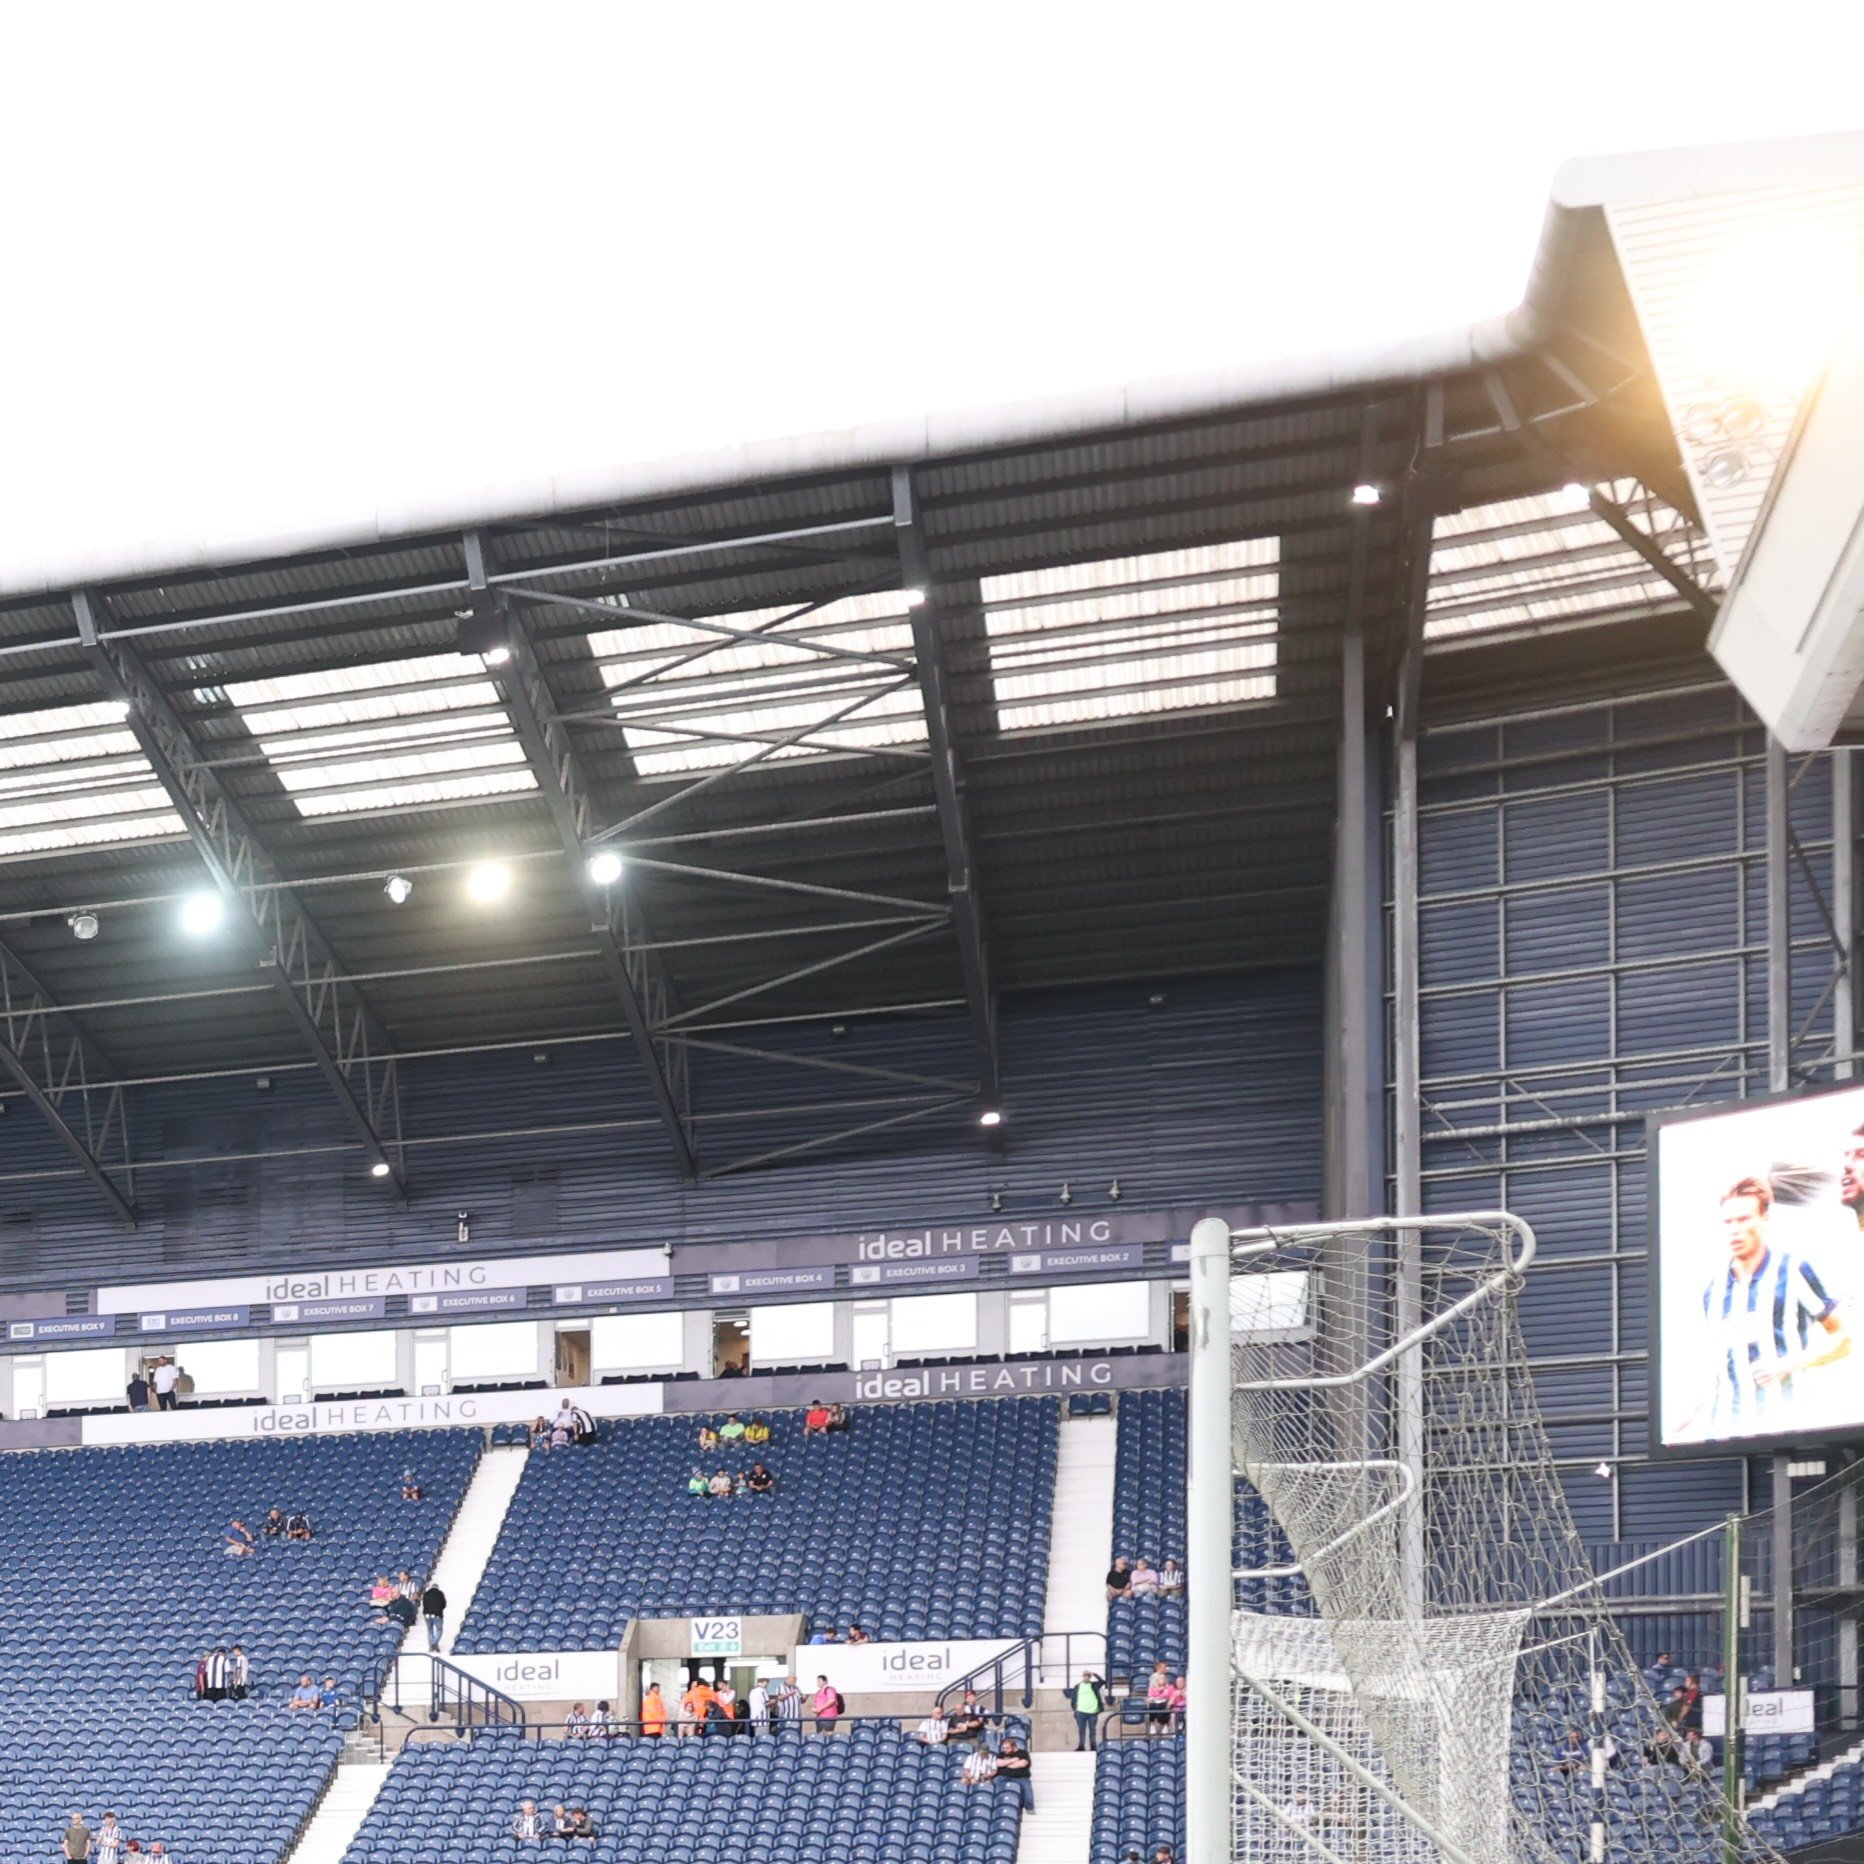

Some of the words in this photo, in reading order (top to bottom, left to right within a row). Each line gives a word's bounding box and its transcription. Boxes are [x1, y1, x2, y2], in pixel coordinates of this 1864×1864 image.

[858, 1231, 931, 1260] ideal
[943, 1221, 1110, 1251] HEATING
[1047, 1253, 1098, 1266] EXECUTIVE
[1100, 1252, 1121, 1262] BOX
[886, 1265, 936, 1277] EXECUTIVE
[938, 1264, 958, 1274] BOX
[266, 1275, 329, 1301] ideal
[340, 1266, 486, 1293] HEATING
[745, 1275, 793, 1287] EXECUTIVE
[795, 1273, 814, 1284] BOX
[587, 1286, 633, 1297] EXECUTIVE
[635, 1284, 654, 1294] BOX
[442, 1295, 488, 1307] EXECUTIVE
[489, 1294, 508, 1304] BOX
[303, 1304, 347, 1315] EXECUTIVE
[349, 1303, 367, 1313] BOX
[170, 1314, 212, 1325] EXECUTIVE
[214, 1313, 232, 1322] BOX
[38, 1323, 80, 1334] EXECUTIVE
[80, 1322, 97, 1331] BOX
[856, 1370, 929, 1399] ideal
[940, 1362, 1112, 1392] HEATING
[253, 1406, 316, 1432] ideal
[328, 1400, 476, 1425] HEATING
[695, 1622, 739, 1640] V23
[883, 1648, 950, 1671] ideal
[497, 1659, 559, 1681] ideal
